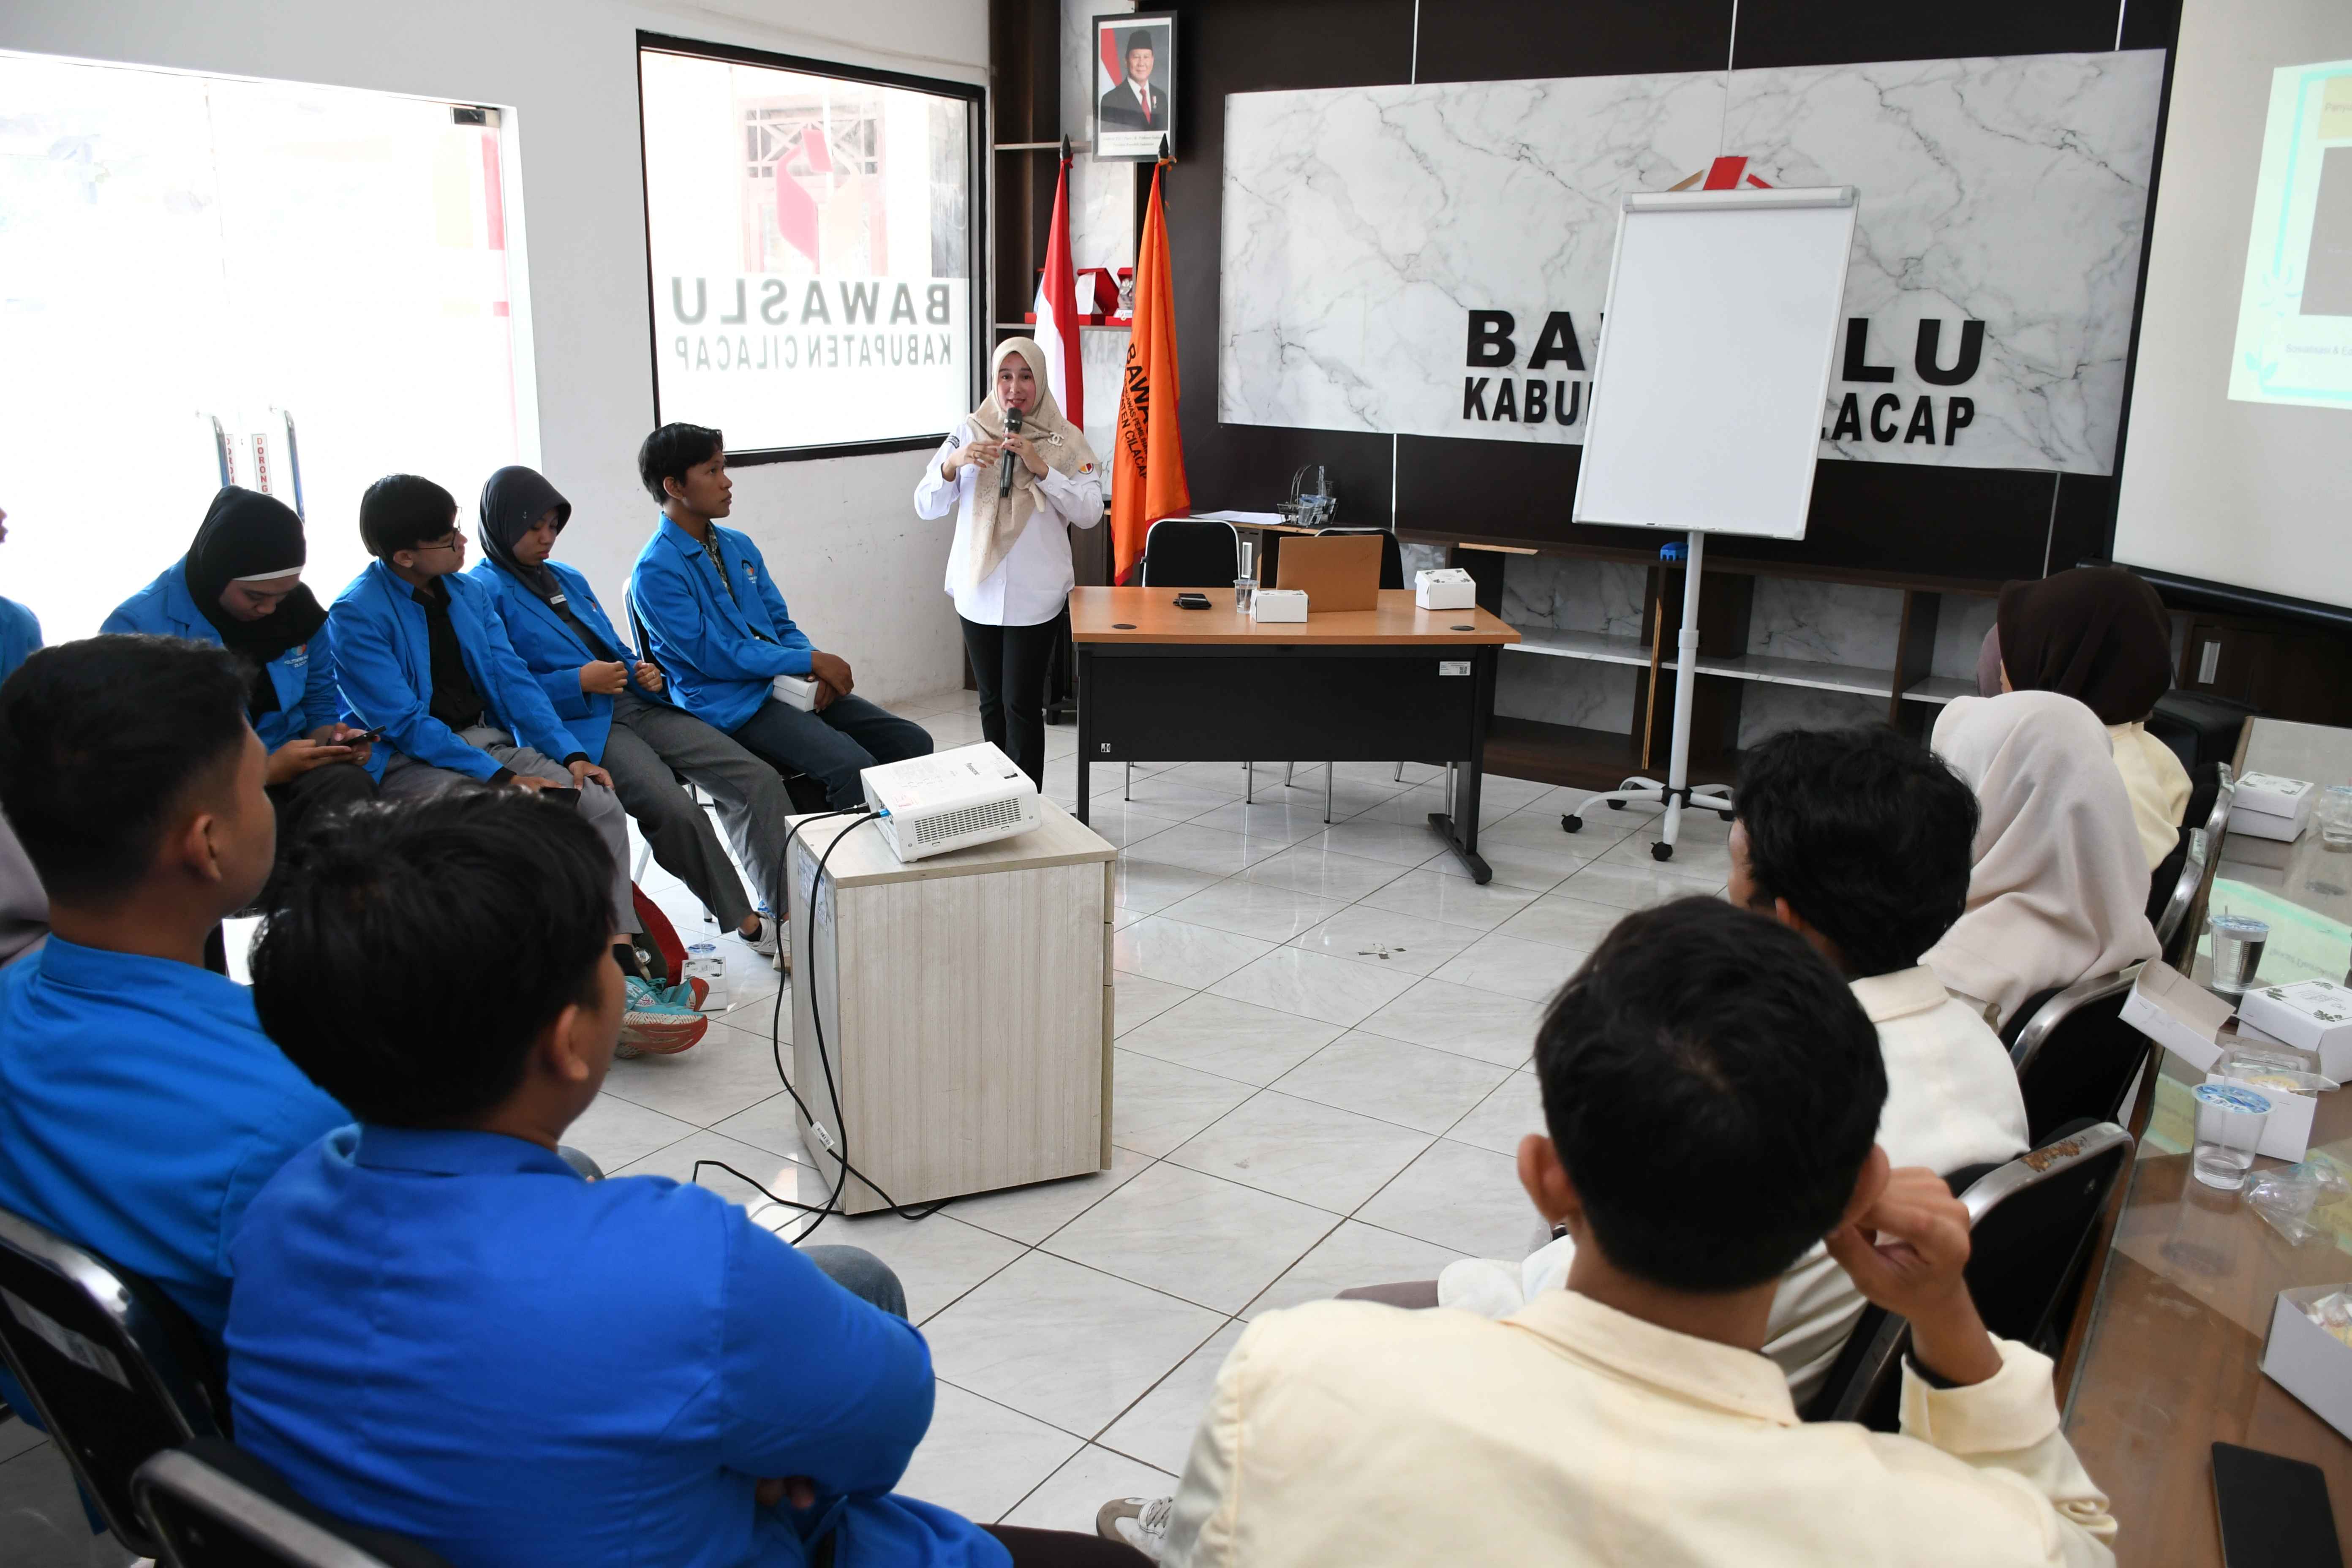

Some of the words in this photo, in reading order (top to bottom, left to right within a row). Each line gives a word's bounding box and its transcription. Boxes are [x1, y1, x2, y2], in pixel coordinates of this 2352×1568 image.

[1127, 342, 1149, 431] BAWA
[1463, 376, 1593, 426] KABU
[1821, 392, 1975, 446] ACAP
[257, 438, 268, 492] DORONG
[1125, 430, 1146, 479] CILACAP
